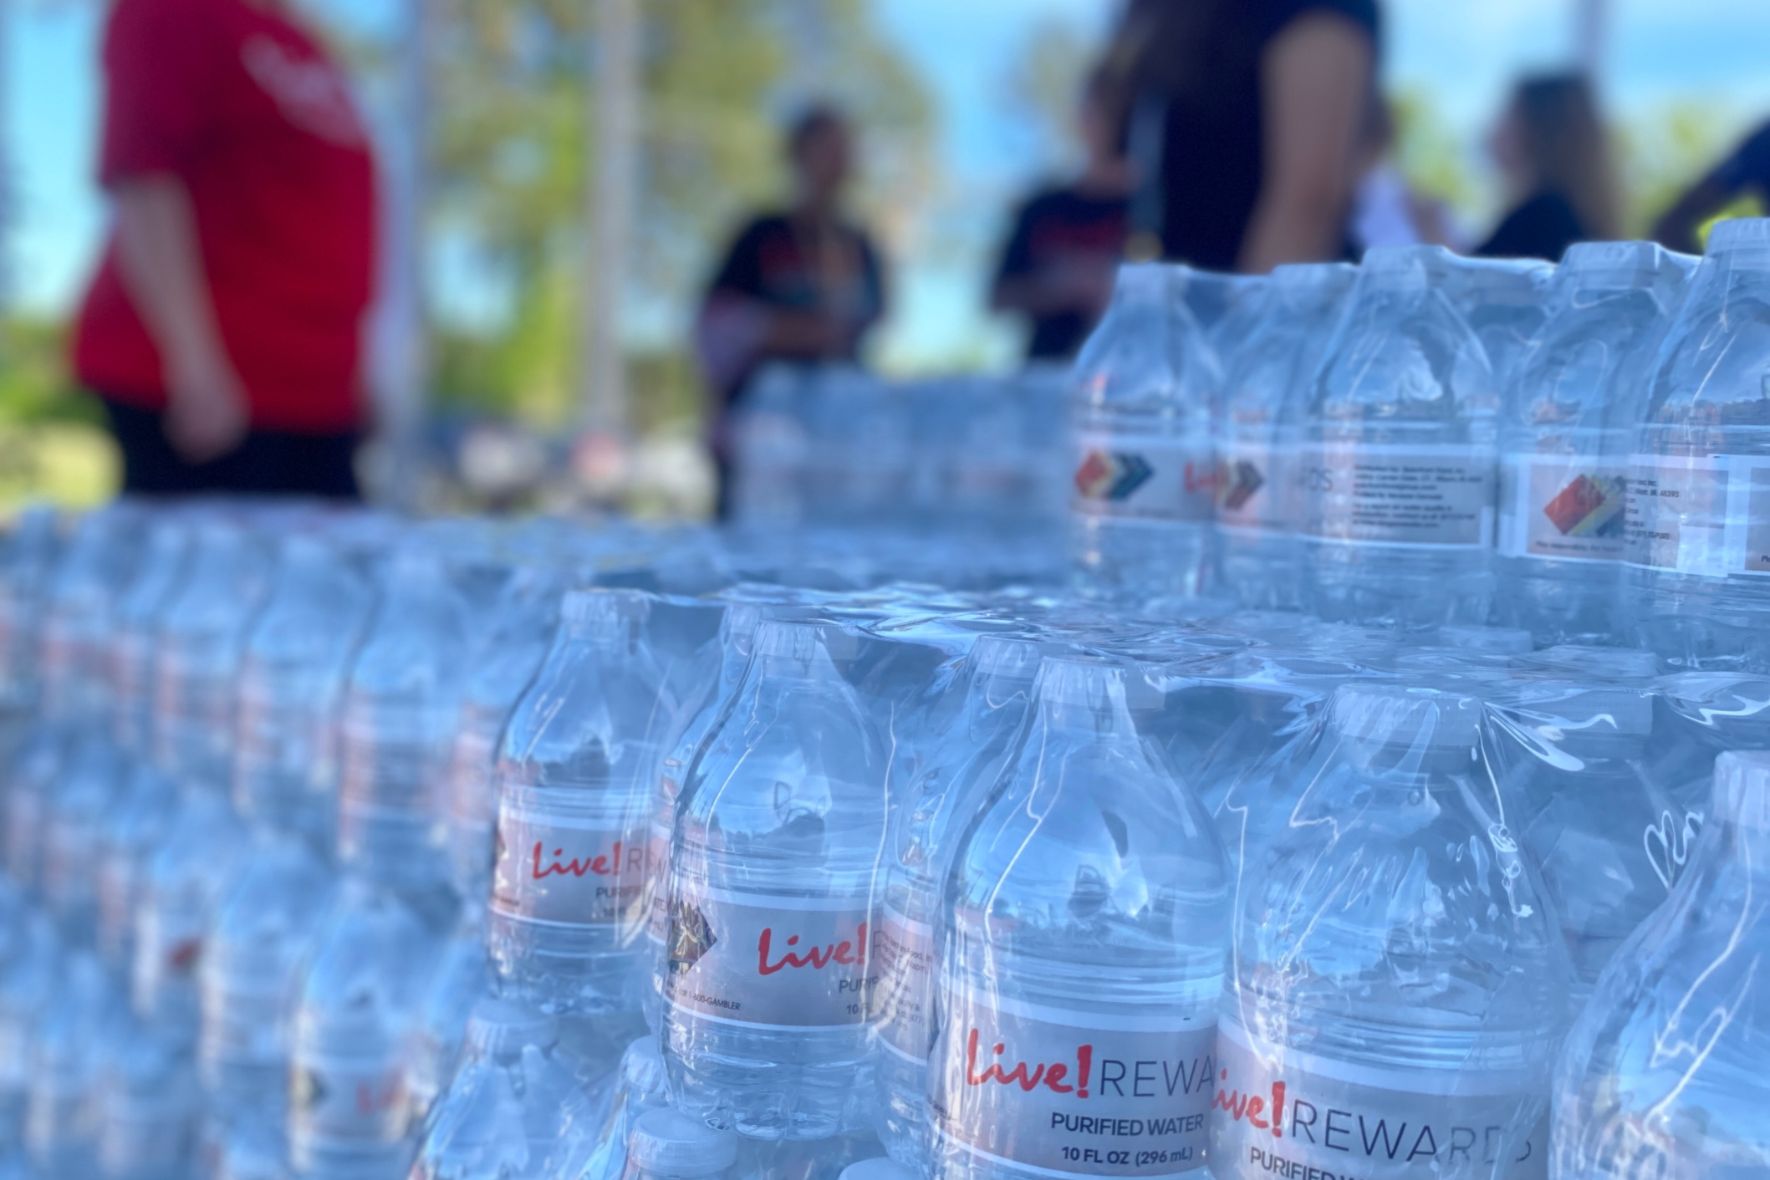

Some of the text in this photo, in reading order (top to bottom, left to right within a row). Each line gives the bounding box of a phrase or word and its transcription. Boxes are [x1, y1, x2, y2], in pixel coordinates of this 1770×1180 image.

[531, 841, 621, 880] Live!
[758, 922, 867, 976] Live!
[966, 1027, 1216, 1099] Live! REWA
[1211, 1068, 1287, 1138] ive!
[1051, 1112, 1204, 1136] PURIFIED WATER
[1061, 1146, 1193, 1167] 10 FL OZ (296 mL)
[1250, 1146, 1336, 1180] PURIFIED
